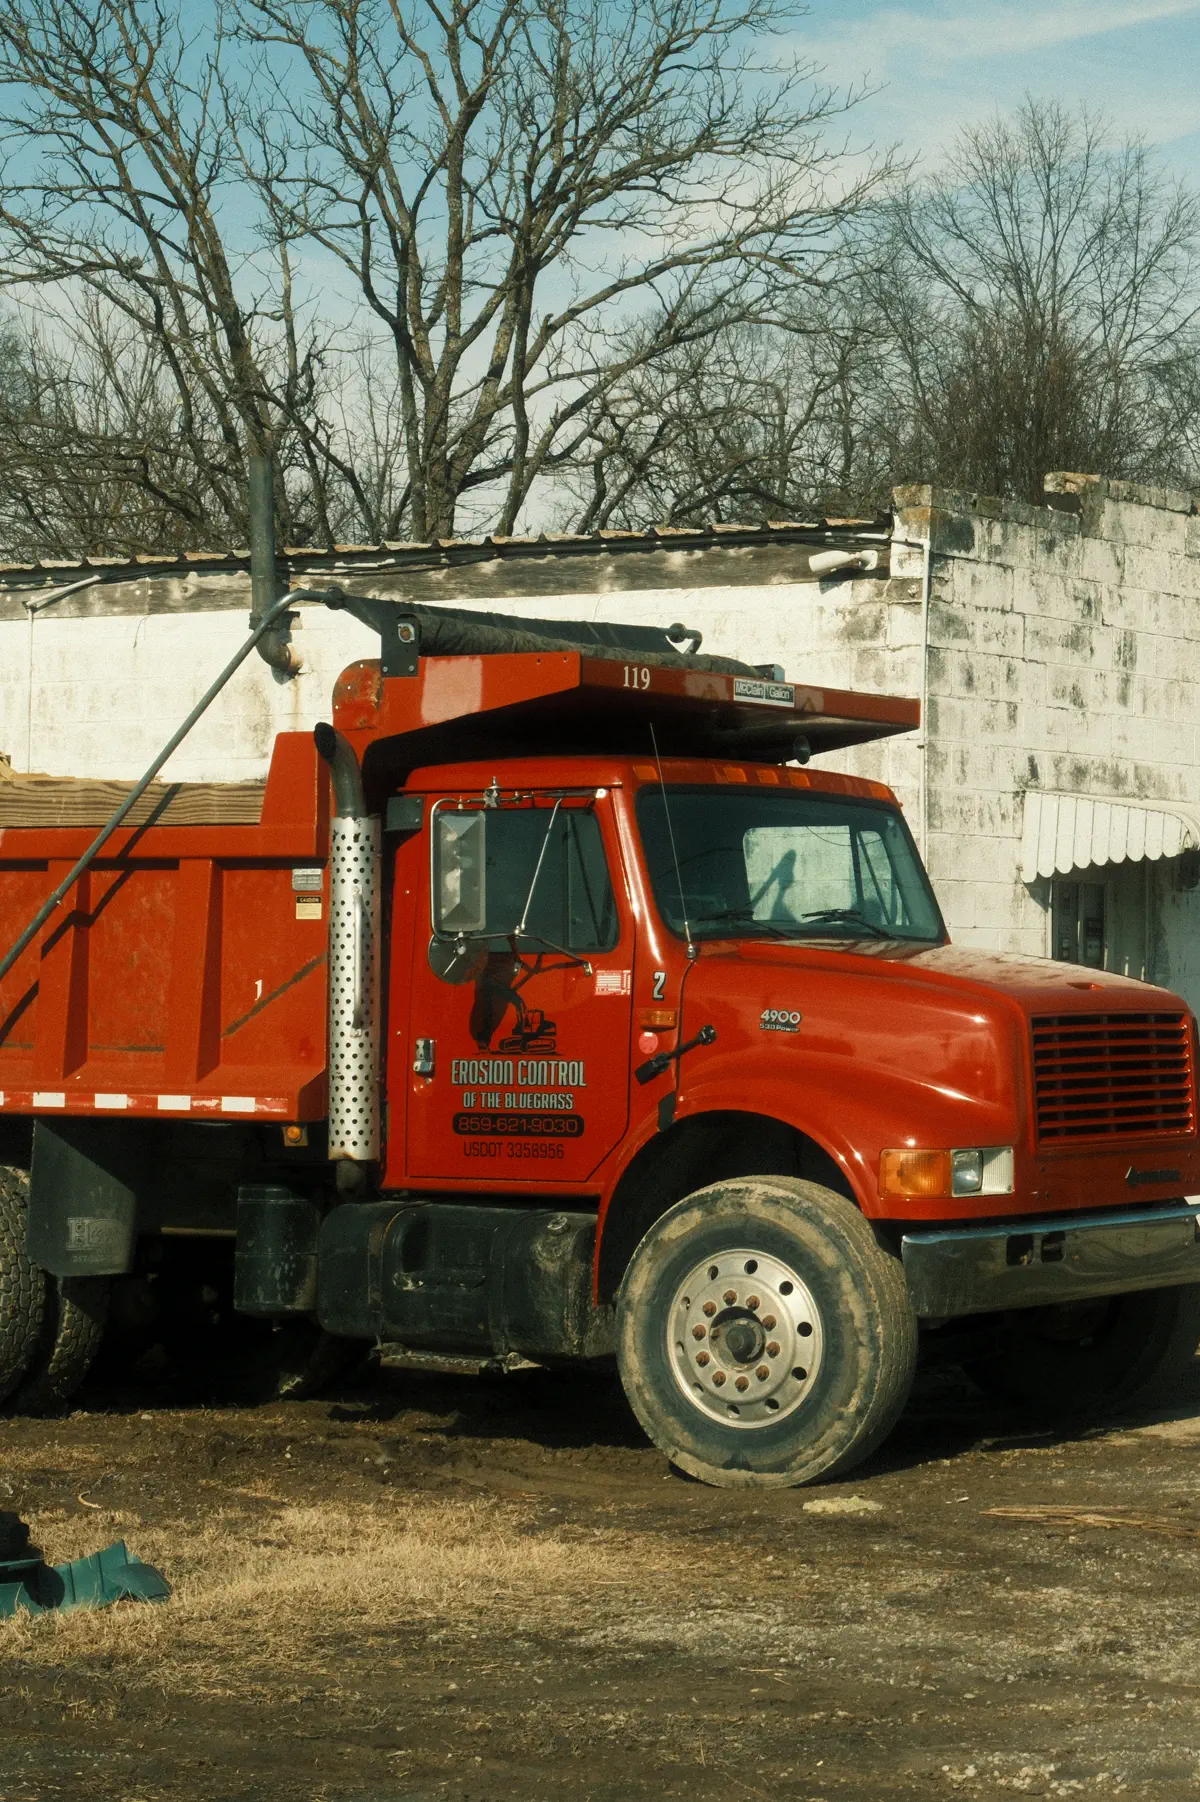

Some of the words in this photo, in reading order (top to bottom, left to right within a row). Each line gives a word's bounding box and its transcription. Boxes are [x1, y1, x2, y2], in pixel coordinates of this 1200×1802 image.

[622, 665, 651, 690] 119
[735, 681, 764, 696] McClain
[652, 970, 667, 1001] 2
[760, 1009, 801, 1024] 4900
[451, 1059, 514, 1085] EROSION
[517, 1060, 587, 1087] CONTROL
[463, 1091, 477, 1108] OF
[480, 1092, 502, 1109] THE
[504, 1092, 574, 1110] BLUEGRASS
[458, 1116, 579, 1133] 859-621-9030
[463, 1141, 504, 1157] USDOT
[507, 1142, 565, 1159] 3358956
